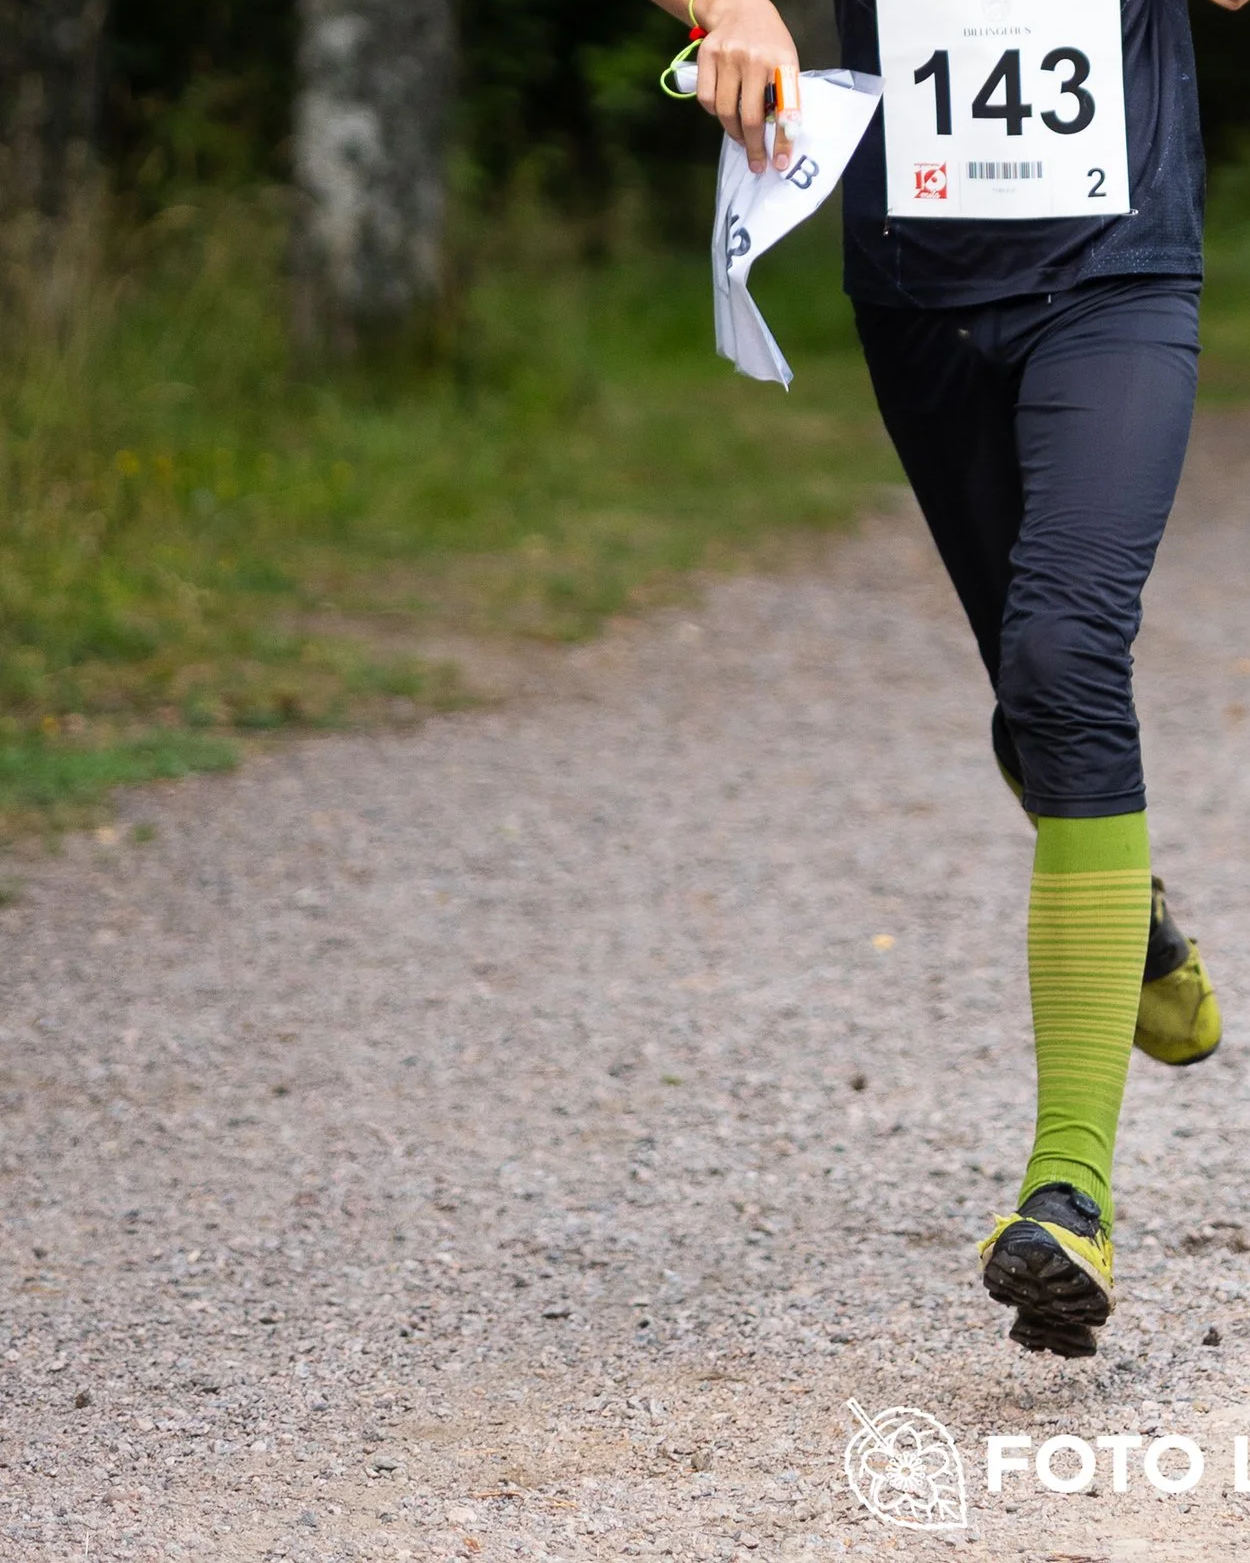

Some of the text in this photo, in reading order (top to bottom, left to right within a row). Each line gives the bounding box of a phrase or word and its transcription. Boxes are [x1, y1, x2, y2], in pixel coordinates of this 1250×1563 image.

[914, 46, 1096, 136] 143
[785, 154, 819, 190] B
[1086, 167, 1107, 198] 2
